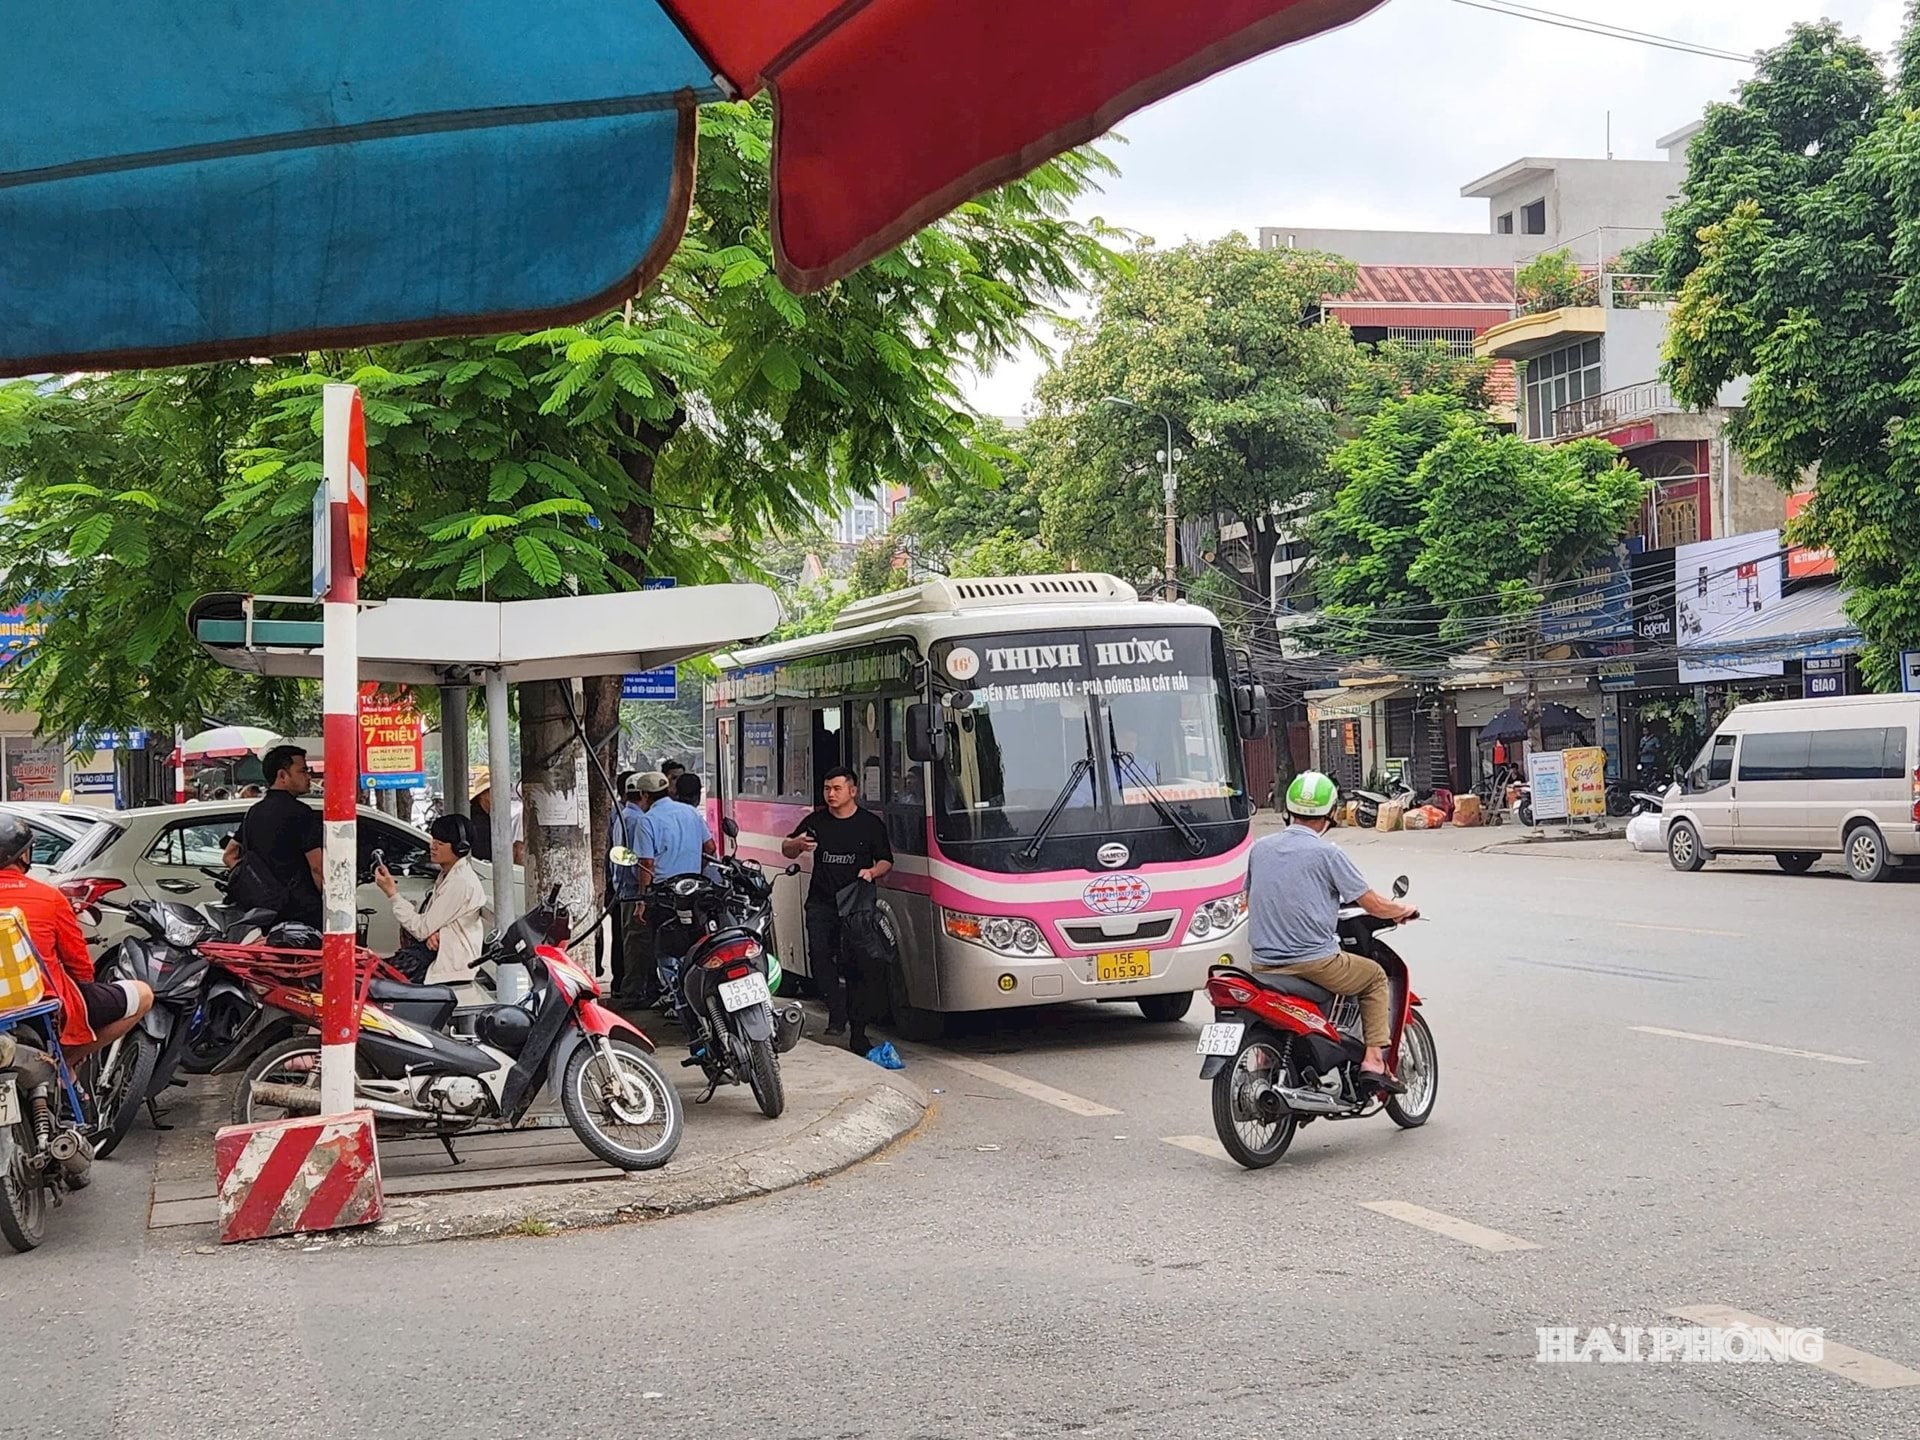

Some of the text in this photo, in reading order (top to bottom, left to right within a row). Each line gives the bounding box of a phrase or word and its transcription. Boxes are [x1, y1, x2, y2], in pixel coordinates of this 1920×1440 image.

[1638, 618, 1670, 638] Legend
[986, 637, 1174, 674] THỊNH HƯNG
[980, 683, 1002, 702] BẾN
[1004, 684, 1020, 699] XE
[1020, 680, 1060, 700] THƯỢNG
[1061, 679, 1074, 697] LÝ
[1133, 675, 1151, 693] BÀI
[1152, 673, 1170, 692] CÁT
[1171, 670, 1189, 691] HẢI
[1811, 677, 1836, 692] GIAO
[360, 714, 392, 726] Giảm
[363, 726, 417, 744] 7 TRIỆU
[1113, 952, 1135, 966] 15E
[1103, 964, 1144, 979] 015.92
[727, 978, 759, 996] 15-B4
[1207, 1025, 1237, 1039] 15-B2
[1198, 1039, 1236, 1053] 515.13
